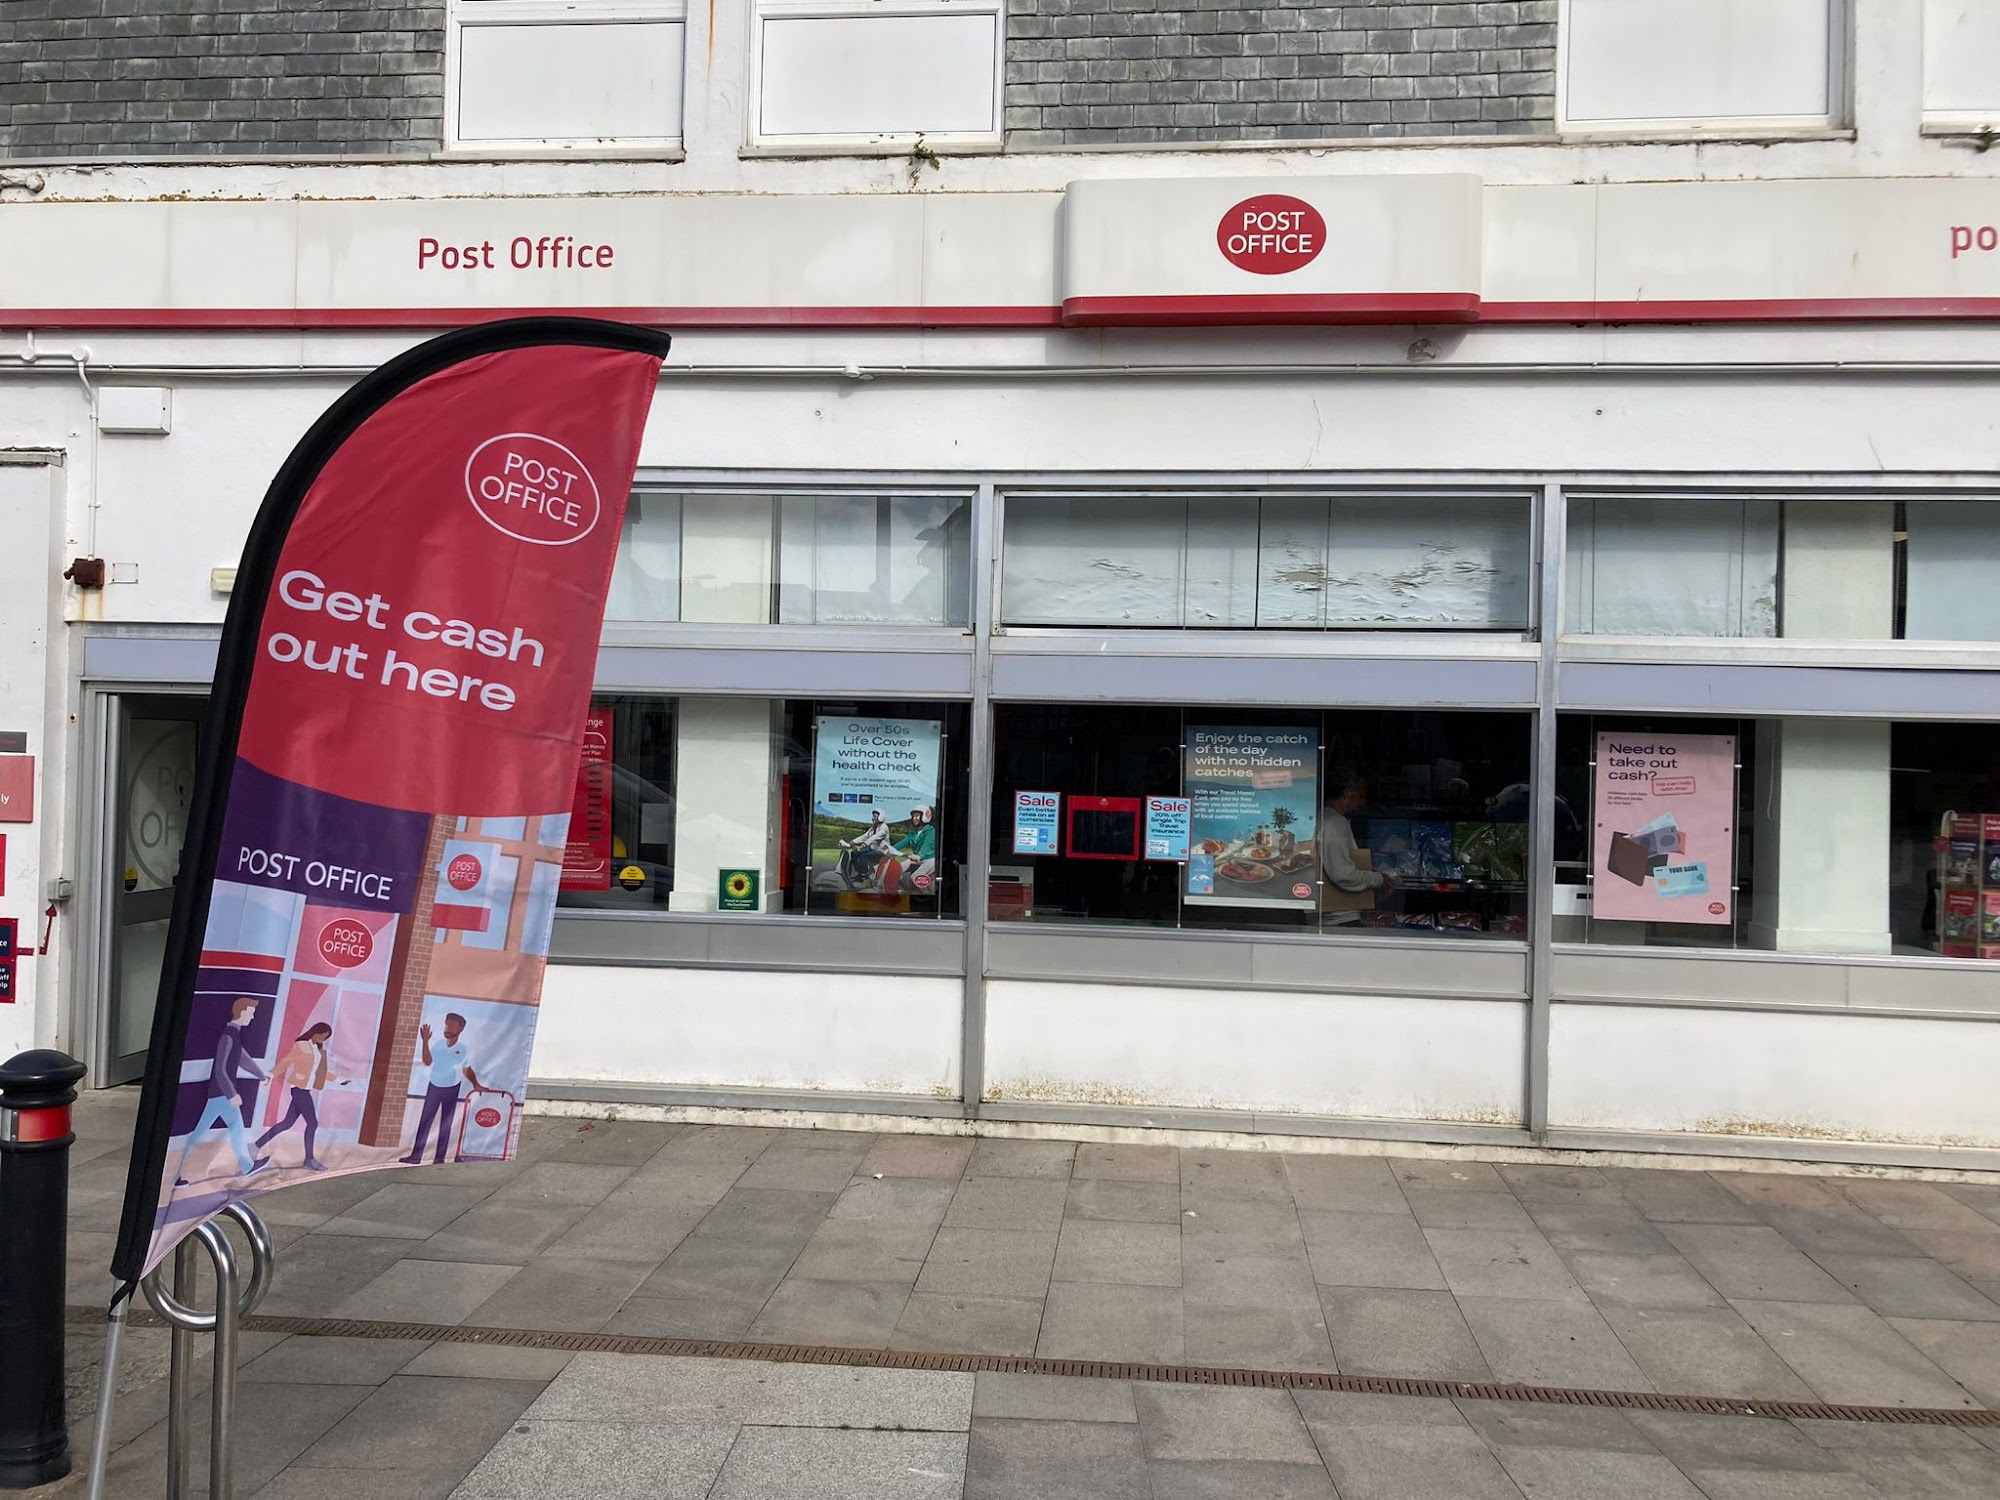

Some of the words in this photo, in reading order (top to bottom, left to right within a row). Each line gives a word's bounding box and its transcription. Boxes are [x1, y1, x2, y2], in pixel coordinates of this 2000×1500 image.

[1243, 212, 1305, 232] POST
[1227, 234, 1313, 254] OFFICE
[418, 238, 494, 270] Post
[510, 236, 614, 268] Office
[504, 452, 578, 495] POST
[480, 475, 582, 527] OFFICE
[278, 570, 391, 630] Get
[403, 610, 545, 668] cash
[267, 632, 368, 680] out
[380, 649, 517, 712] here
[848, 724, 880, 734] Over
[885, 725, 910, 735] 50s
[843, 736, 868, 745] Life
[872, 737, 914, 747] Cover
[1195, 733, 1234, 744] Enjoy
[1238, 734, 1262, 743] the
[1266, 734, 1308, 744] catch
[838, 748, 890, 759] without
[894, 750, 917, 760] the
[1195, 744, 1211, 754] of
[1214, 746, 1238, 754] the
[1242, 746, 1268, 756] day
[1609, 744, 1654, 754] Need
[1658, 746, 1676, 755] to
[832, 760, 875, 770] health
[878, 762, 921, 772] check
[1195, 756, 1226, 766] with
[1251, 757, 1301, 766] hidden
[1608, 757, 1646, 767] take
[1650, 758, 1678, 768] out
[1195, 768, 1254, 778] catches
[1608, 770, 1658, 780] cash?
[1020, 795, 1056, 806] Sale
[1150, 800, 1188, 812] Sale
[456, 861, 476, 872] POST
[1668, 866, 1683, 874] YOUR
[238, 846, 300, 881] POST
[305, 861, 394, 900] OFFICE
[450, 870, 477, 883] OFFICE
[333, 928, 365, 944] POST
[323, 940, 366, 958] OFFICE
